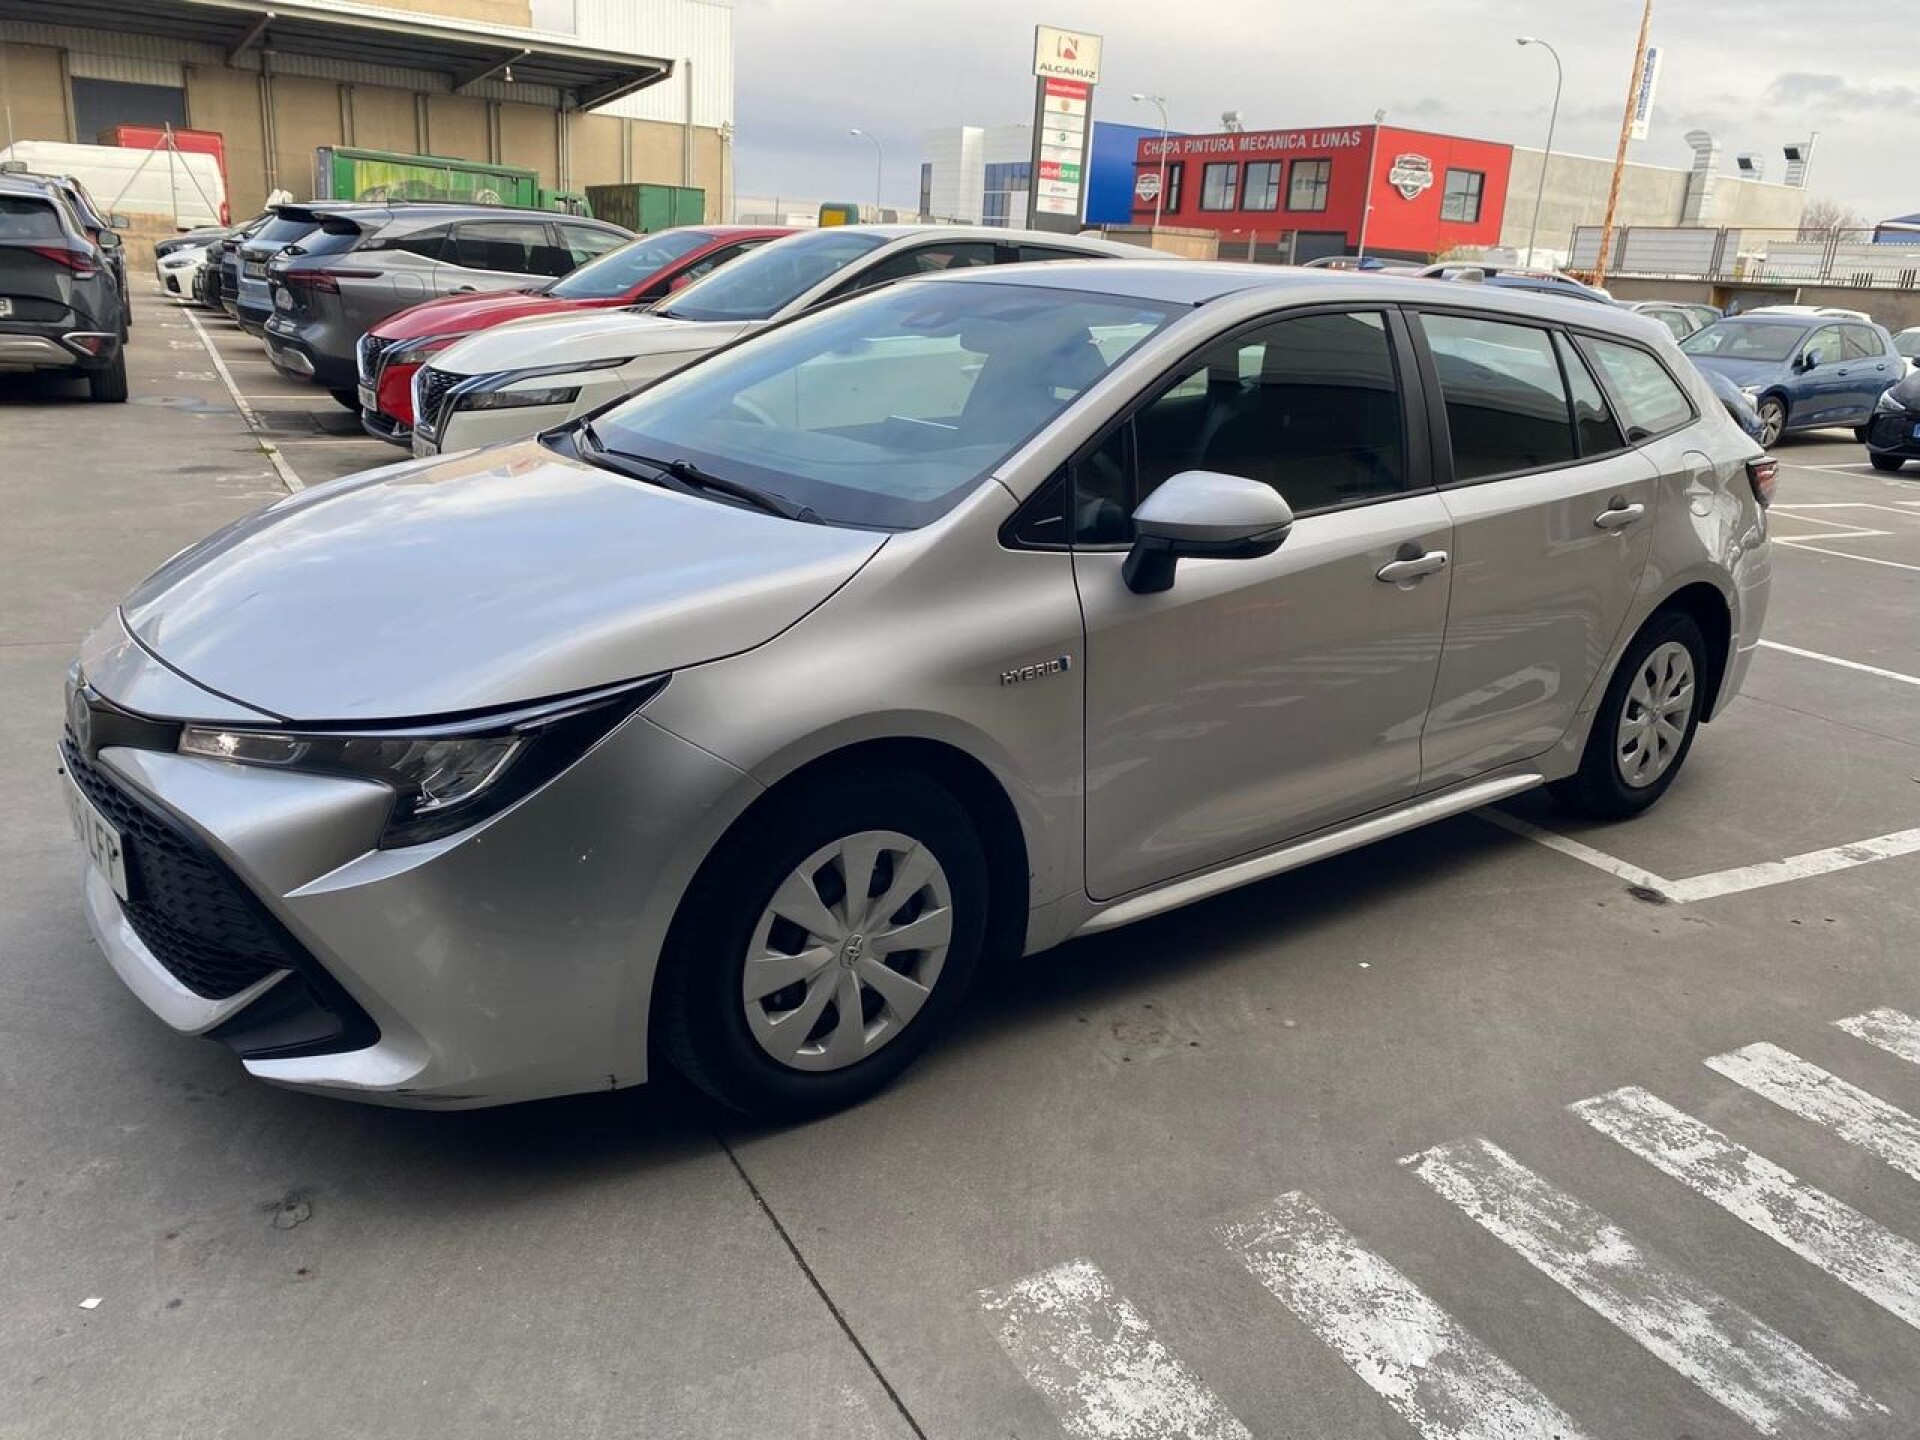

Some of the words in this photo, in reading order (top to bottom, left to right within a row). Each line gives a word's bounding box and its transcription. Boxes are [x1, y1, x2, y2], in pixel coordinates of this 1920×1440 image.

[1039, 62, 1096, 79] ALCAHUZ
[1144, 141, 1180, 156] CHAPA
[1184, 137, 1234, 154] PINTURA
[1239, 133, 1306, 151] MECANICA
[1311, 130, 1362, 148] LUNAS
[999, 660, 1059, 686] HYBRID
